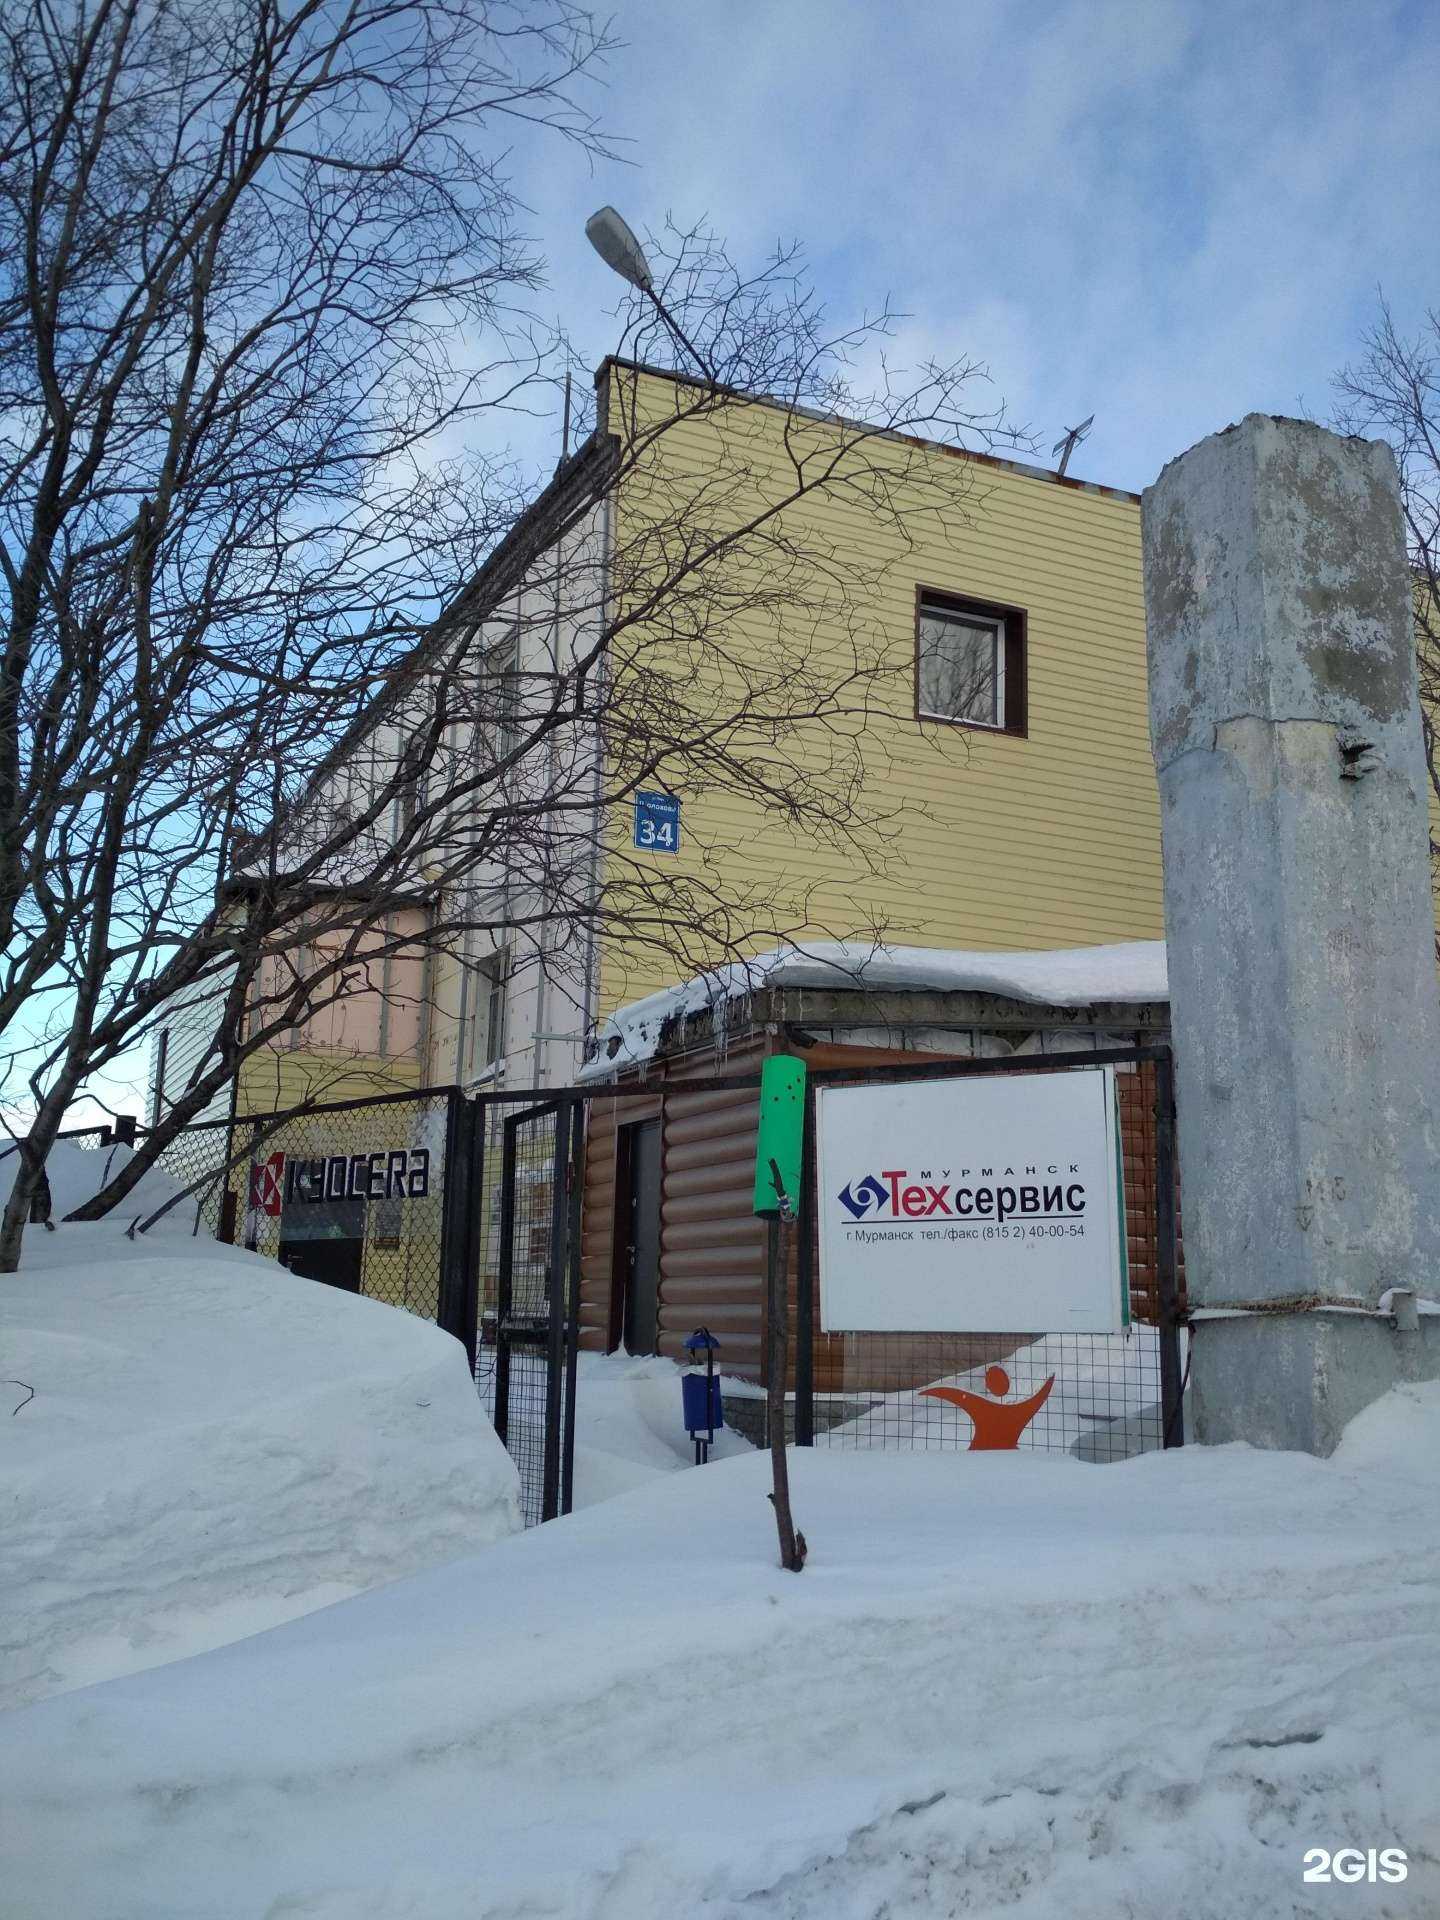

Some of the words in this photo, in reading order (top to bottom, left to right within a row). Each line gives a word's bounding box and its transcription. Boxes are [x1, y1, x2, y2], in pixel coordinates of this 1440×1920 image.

[641, 819, 673, 847] 34
[288, 1148, 430, 1204] KYOCERA
[920, 1163, 1080, 1179] МУРМАНСК
[920, 1227, 979, 1242] тел./факс
[1027, 1223, 1085, 1238] 40-00-54
